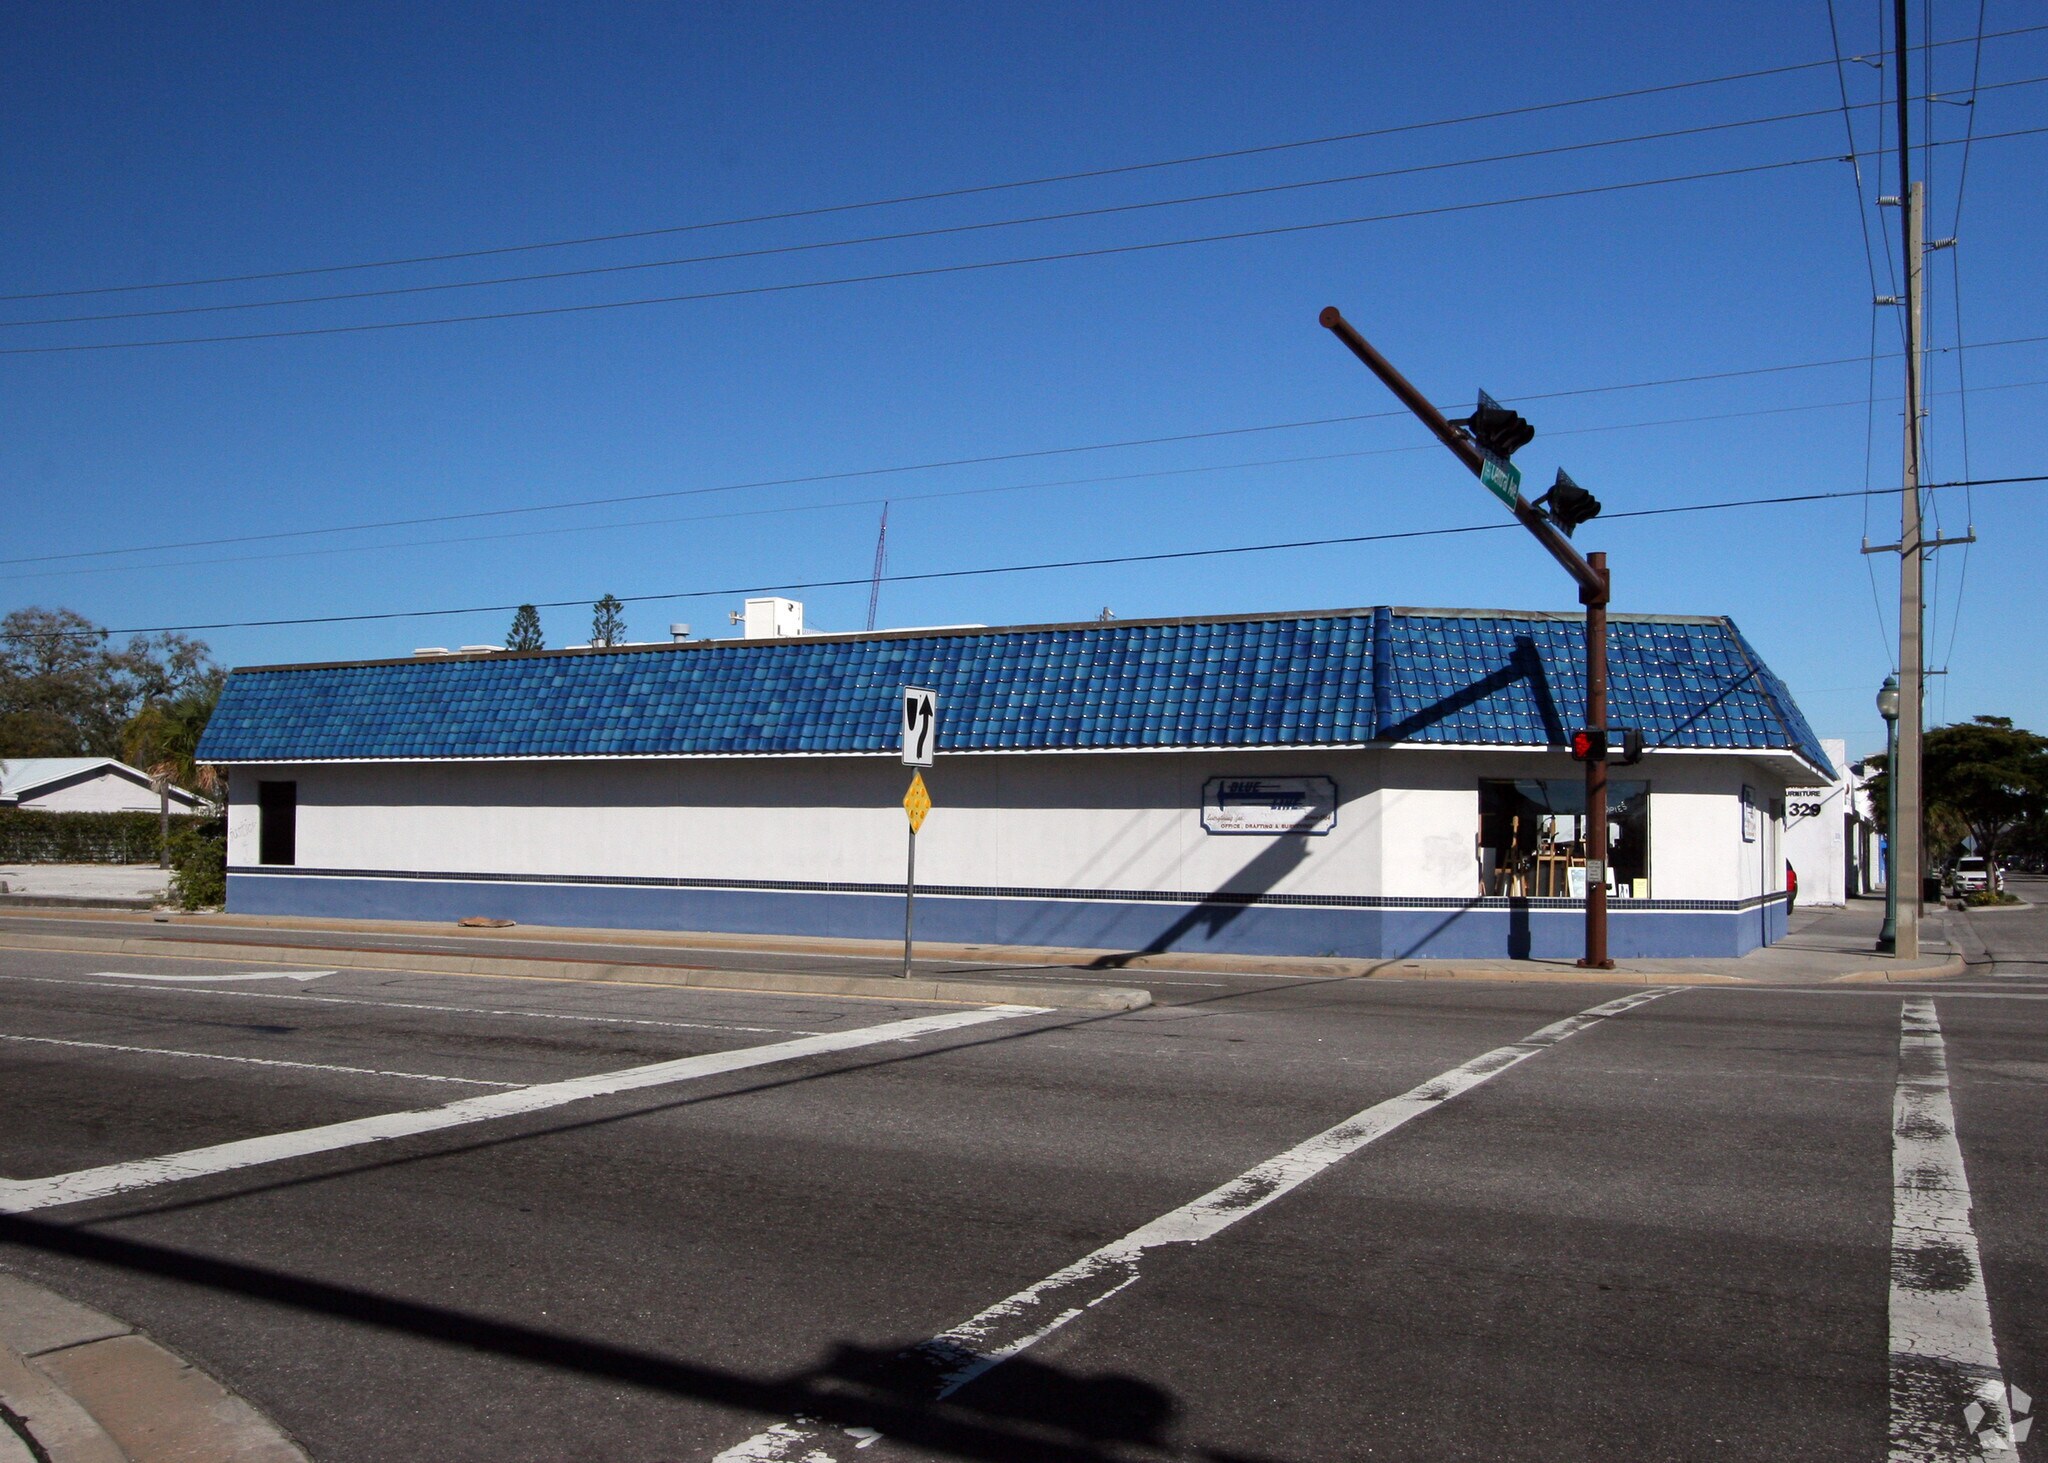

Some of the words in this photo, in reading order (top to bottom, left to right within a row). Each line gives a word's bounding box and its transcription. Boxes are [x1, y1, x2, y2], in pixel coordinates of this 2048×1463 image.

[1230, 782, 1262, 793] BLUE
[1271, 799, 1301, 810] LINE
[1606, 801, 1627, 813] OPIES
[1789, 803, 1822, 818] 329
